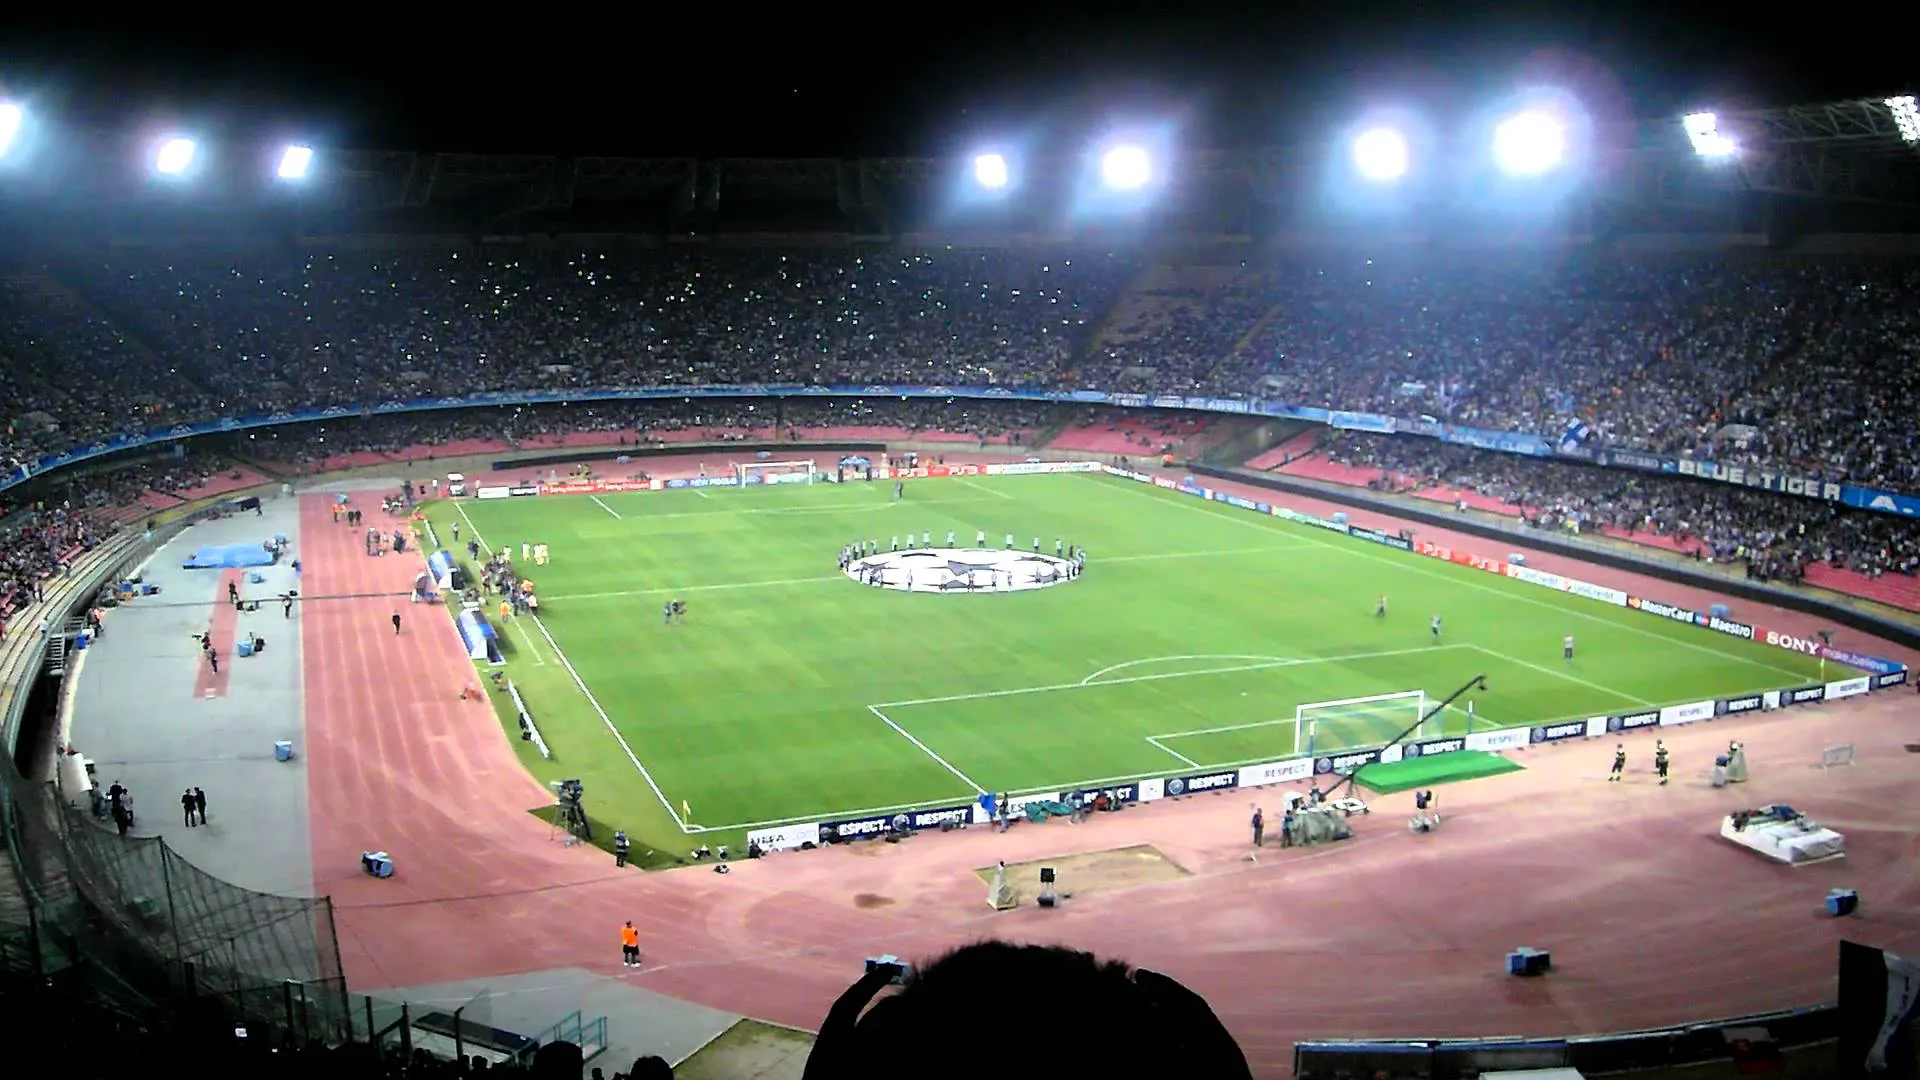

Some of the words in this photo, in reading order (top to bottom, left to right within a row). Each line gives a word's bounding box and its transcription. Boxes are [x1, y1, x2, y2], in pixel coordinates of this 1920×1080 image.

[1678, 459, 1744, 484] BLUE
[1760, 471, 1840, 501] TIGER
[1640, 599, 1694, 623] MasterCard
[1709, 616, 1751, 637] Maestro
[1766, 631, 1820, 655] SONY
[1727, 697, 1760, 711] RESPECT
[1623, 712, 1658, 728] RESPECT
[1546, 723, 1583, 739] RESPECT
[1422, 740, 1463, 755] RESPECT
[1264, 763, 1306, 779] RESPECT
[1188, 773, 1235, 790] RESPECT
[837, 819, 886, 836] ESPECT
